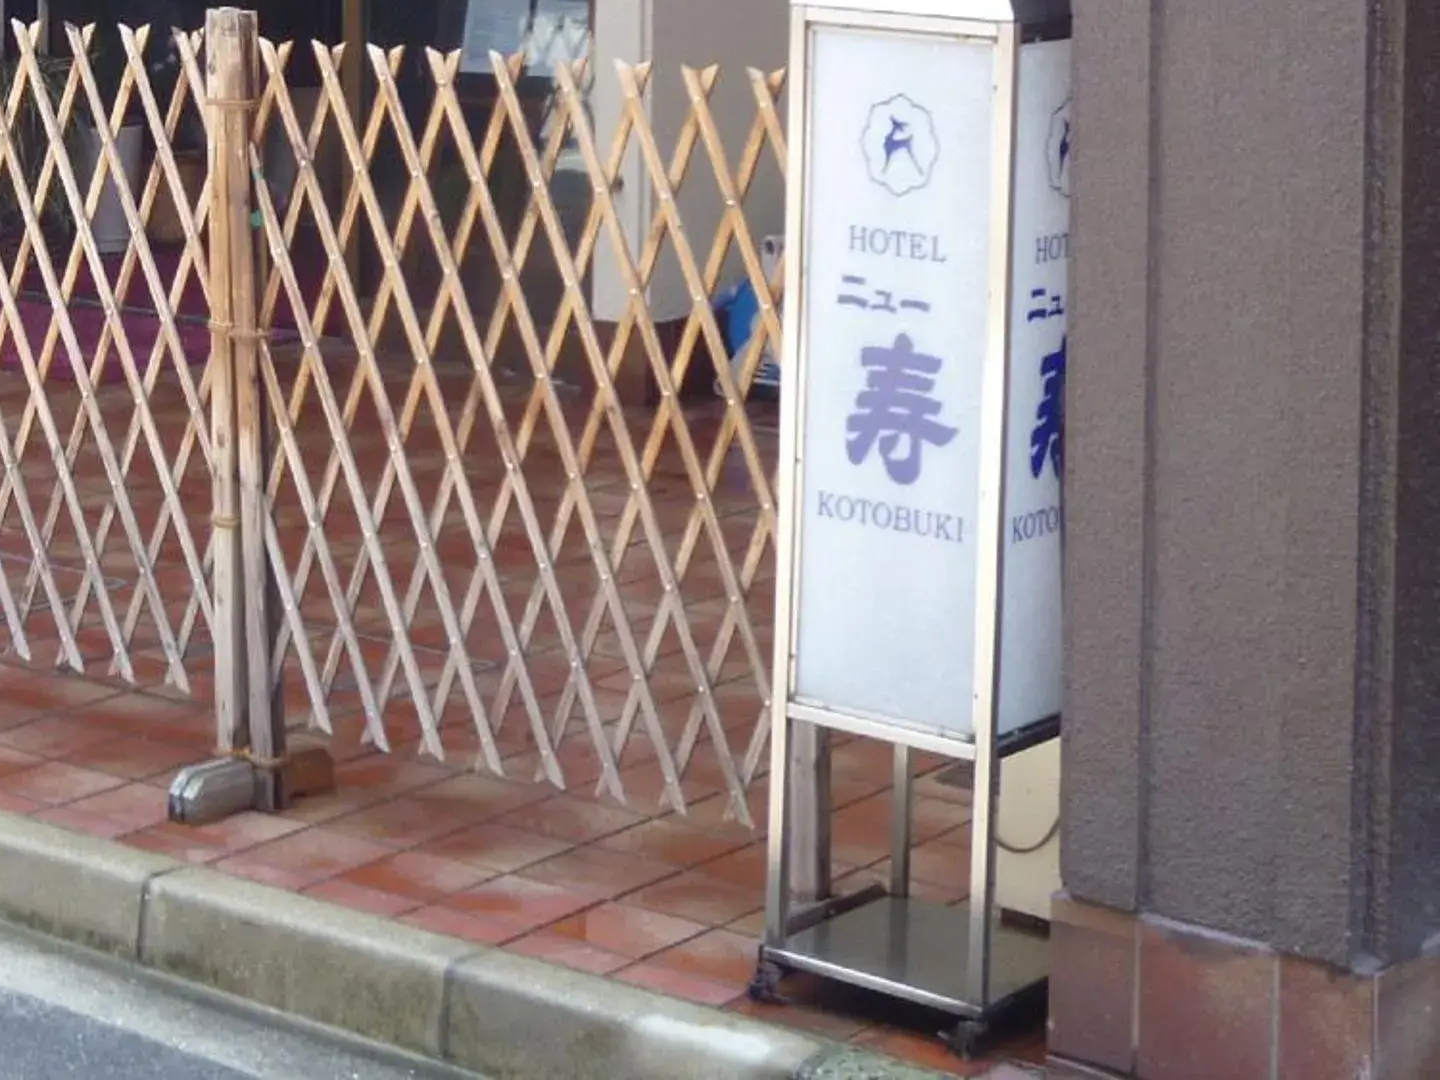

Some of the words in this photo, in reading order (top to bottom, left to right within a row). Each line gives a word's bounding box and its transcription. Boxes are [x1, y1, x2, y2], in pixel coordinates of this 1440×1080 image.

[848, 224, 947, 263] HOTEL
[1034, 232, 1069, 265] HOT
[837, 275, 930, 313] ニュー
[1027, 288, 1064, 322] ニュ
[845, 332, 959, 485] 寿
[816, 490, 964, 542] KOTOBUKI
[1012, 505, 1060, 545] KOTO
